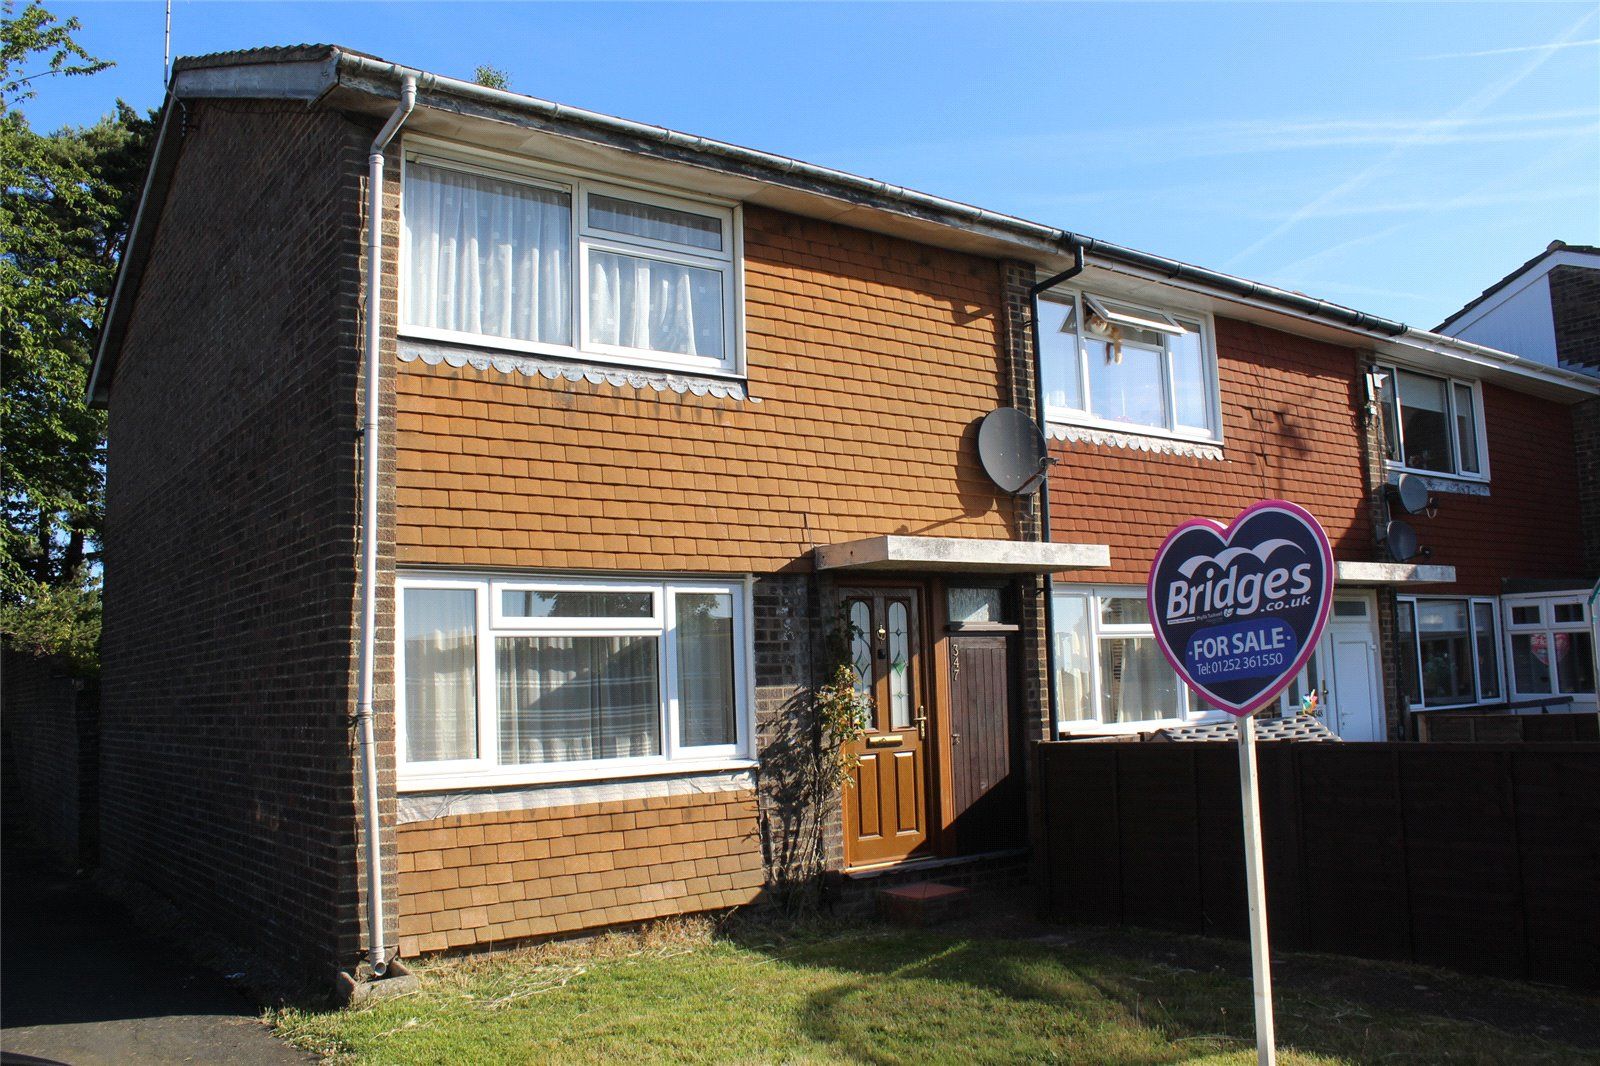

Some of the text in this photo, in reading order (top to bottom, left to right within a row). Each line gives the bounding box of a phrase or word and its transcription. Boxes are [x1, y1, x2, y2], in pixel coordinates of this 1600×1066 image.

[1166, 563, 1312, 616] Bridges
[1260, 595, 1312, 613] .co.uk
[1193, 626, 1285, 661] FOR SALE
[1242, 652, 1283, 669] 361550
